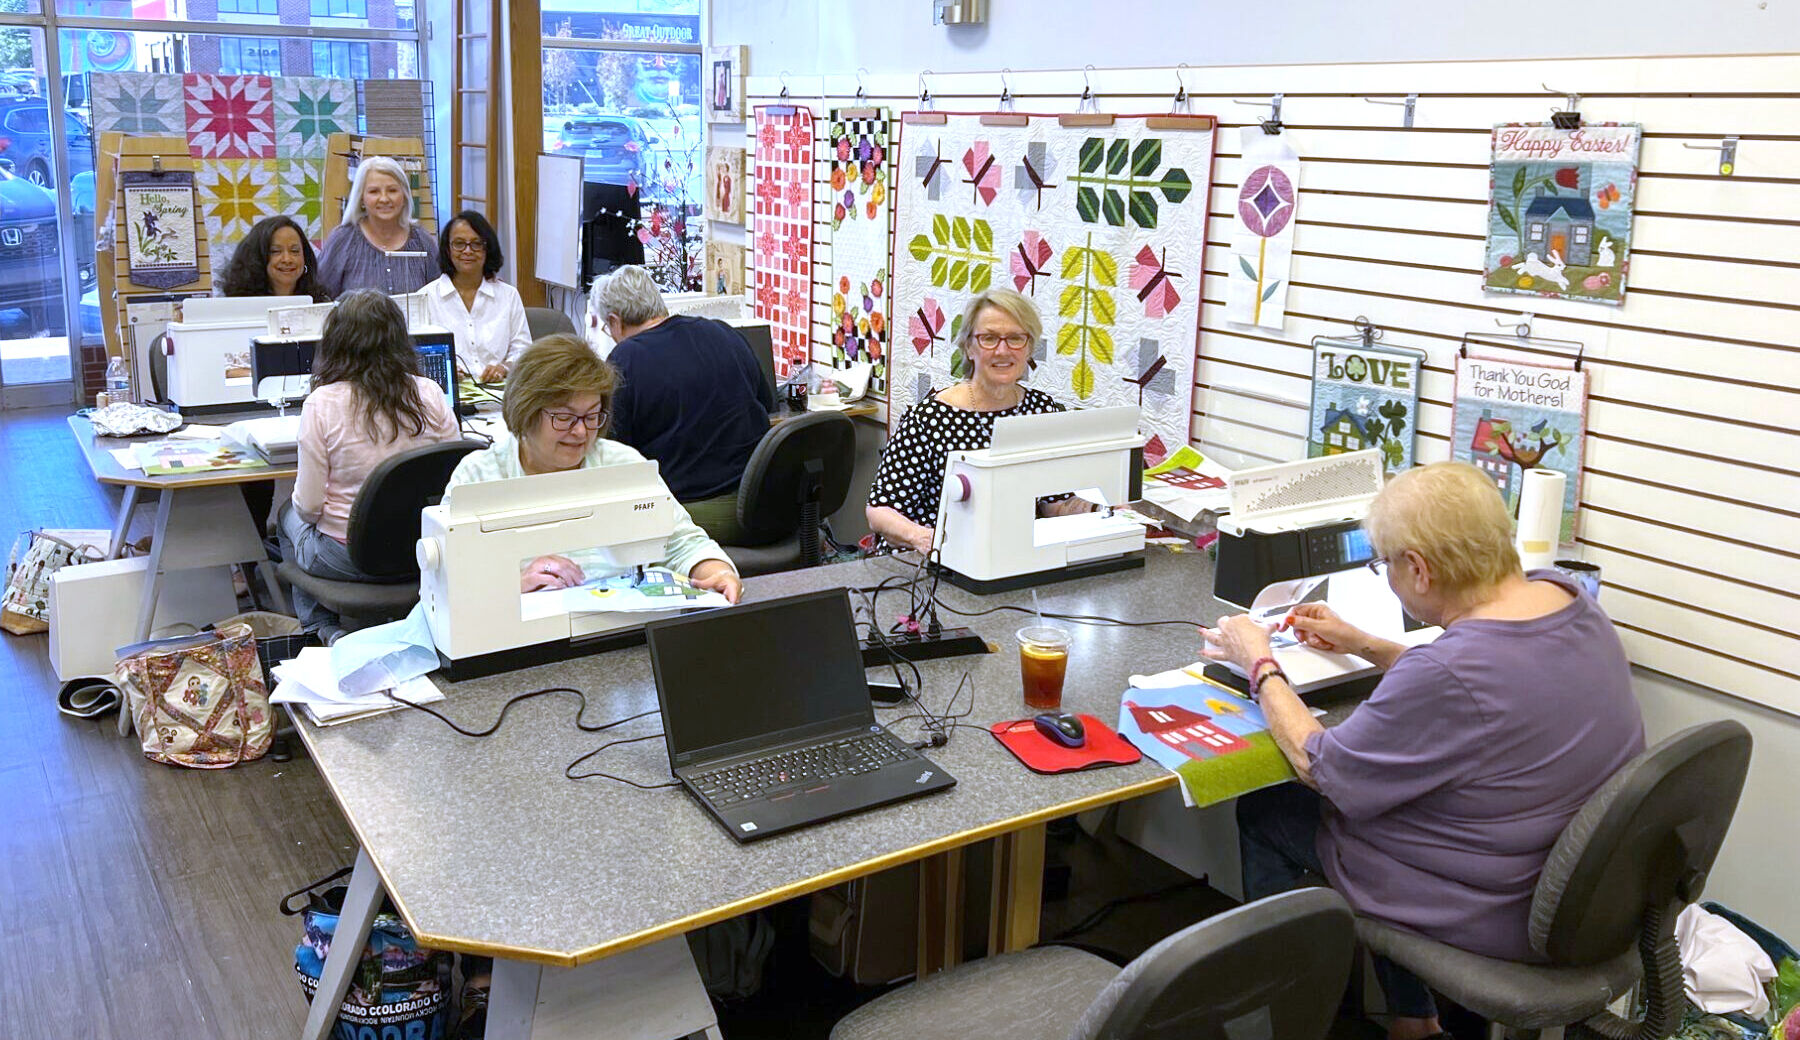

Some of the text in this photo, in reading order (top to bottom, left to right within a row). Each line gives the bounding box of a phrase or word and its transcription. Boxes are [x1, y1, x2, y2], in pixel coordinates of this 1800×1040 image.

[622, 23, 693, 40] GREAT OUTDOOR
[1501, 130, 1631, 158] Happy Easter!
[152, 203, 187, 218] Spring
[1320, 351, 1412, 389] LOVE
[1469, 364, 1571, 391] Thank You God
[1473, 381, 1495, 398] for
[633, 502, 655, 511] PFAFF
